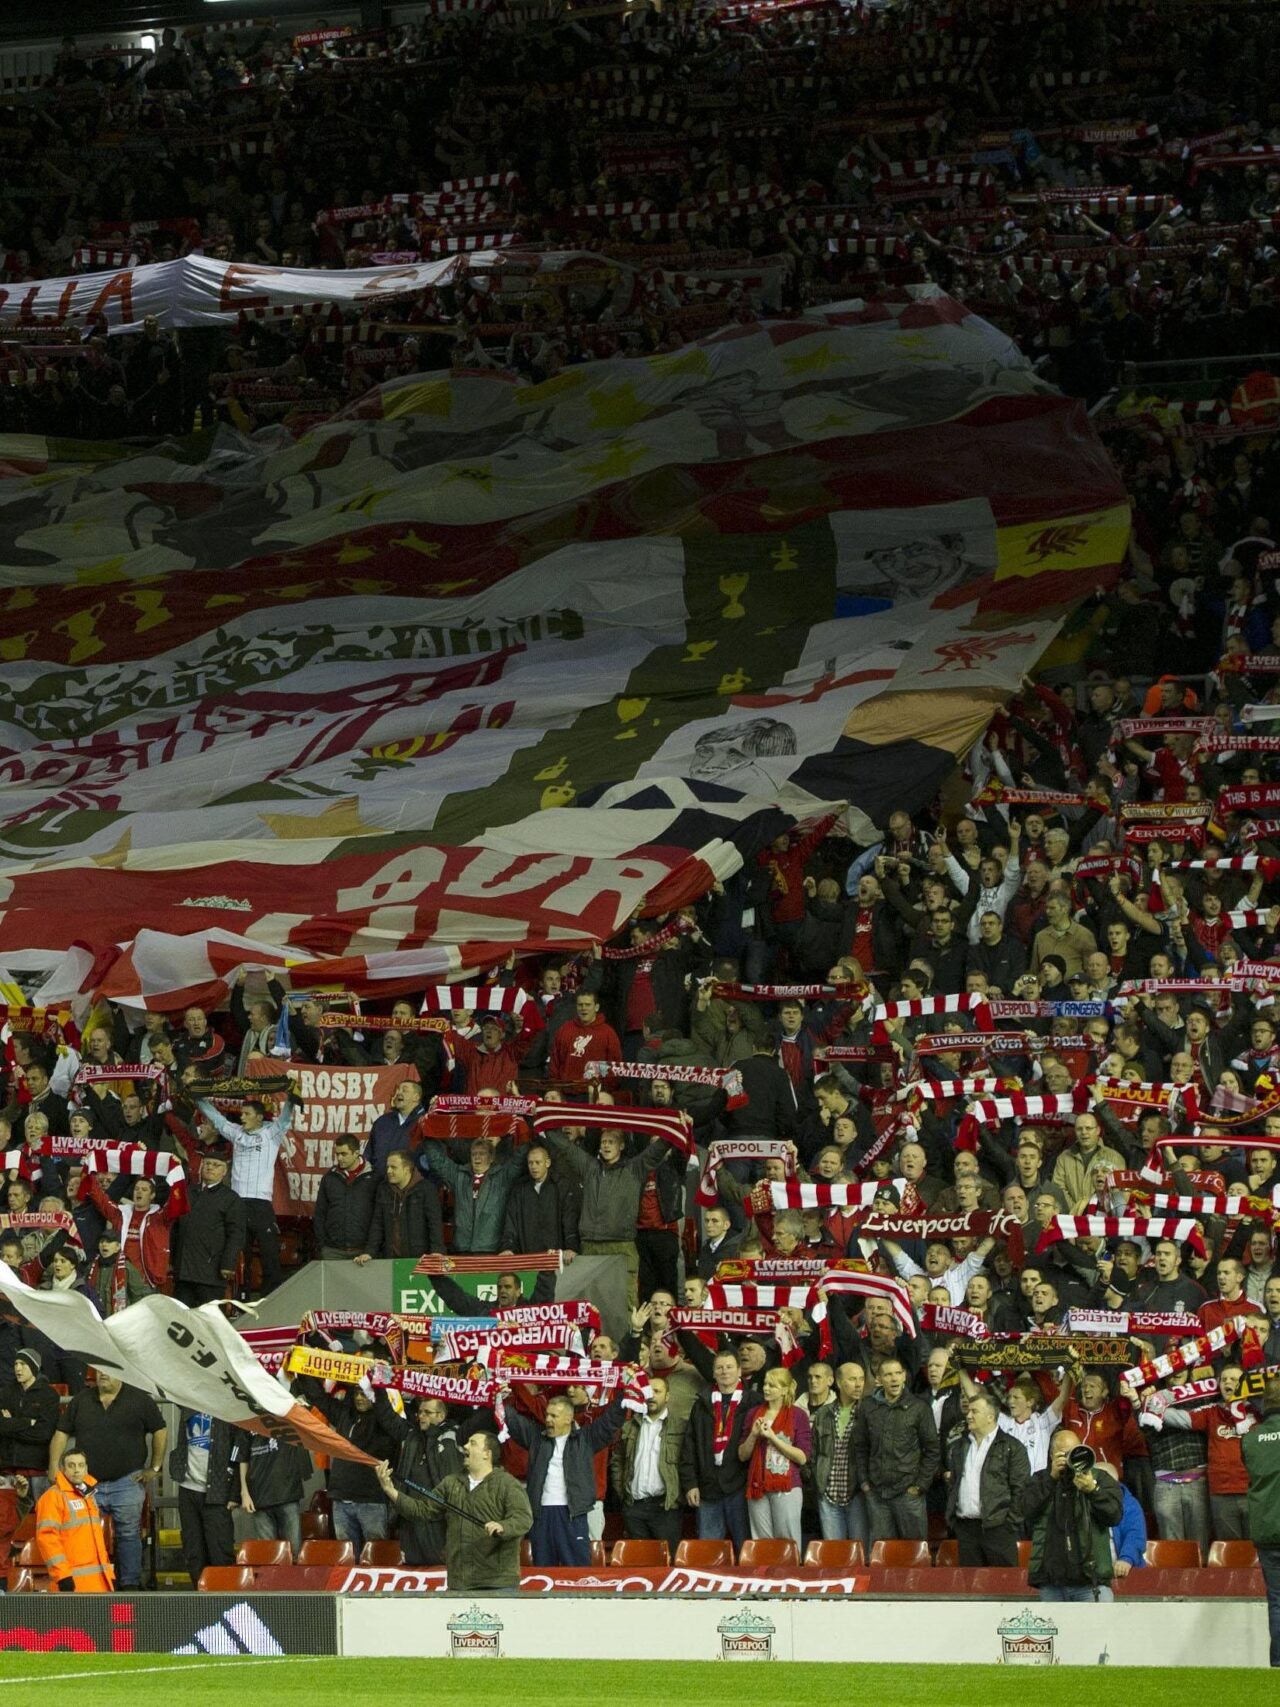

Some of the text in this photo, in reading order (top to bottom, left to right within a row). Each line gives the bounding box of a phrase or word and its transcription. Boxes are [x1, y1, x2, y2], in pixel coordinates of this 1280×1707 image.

[1226, 791, 1261, 806] THIS IS
[991, 1002, 1035, 1017] LIVERPOOL
[1064, 1002, 1103, 1017] RANGERS
[692, 1075, 721, 1087] ALONE
[438, 1096, 472, 1106] LIVERPOOL
[492, 1097, 501, 1106] SL
[503, 1097, 537, 1109] BENFICA
[51, 1137, 110, 1150] LIVERPOOL
[10, 1212, 58, 1226] LIVERPOOL
[862, 1210, 971, 1237] Liverpool
[754, 1257, 827, 1271] LIVERPOOL
[496, 1301, 590, 1323] LIVERPOOL FC
[1070, 1313, 1123, 1323] ATLETICO
[316, 1311, 387, 1331] LIVERPOOL FC
[457, 1325, 568, 1352] LIVERPOOL FC
[510, 1367, 603, 1378] LIVERPOOL FC
[402, 1370, 493, 1396] LIVERPOOL FC
[402, 1381, 489, 1403] YOU'LL NEVER WALK ALONE
[454, 1638, 497, 1649] LIVERPOOL
[724, 1641, 769, 1652] LIVERPOOL
[1005, 1642, 1051, 1654] LIVERPOOL
